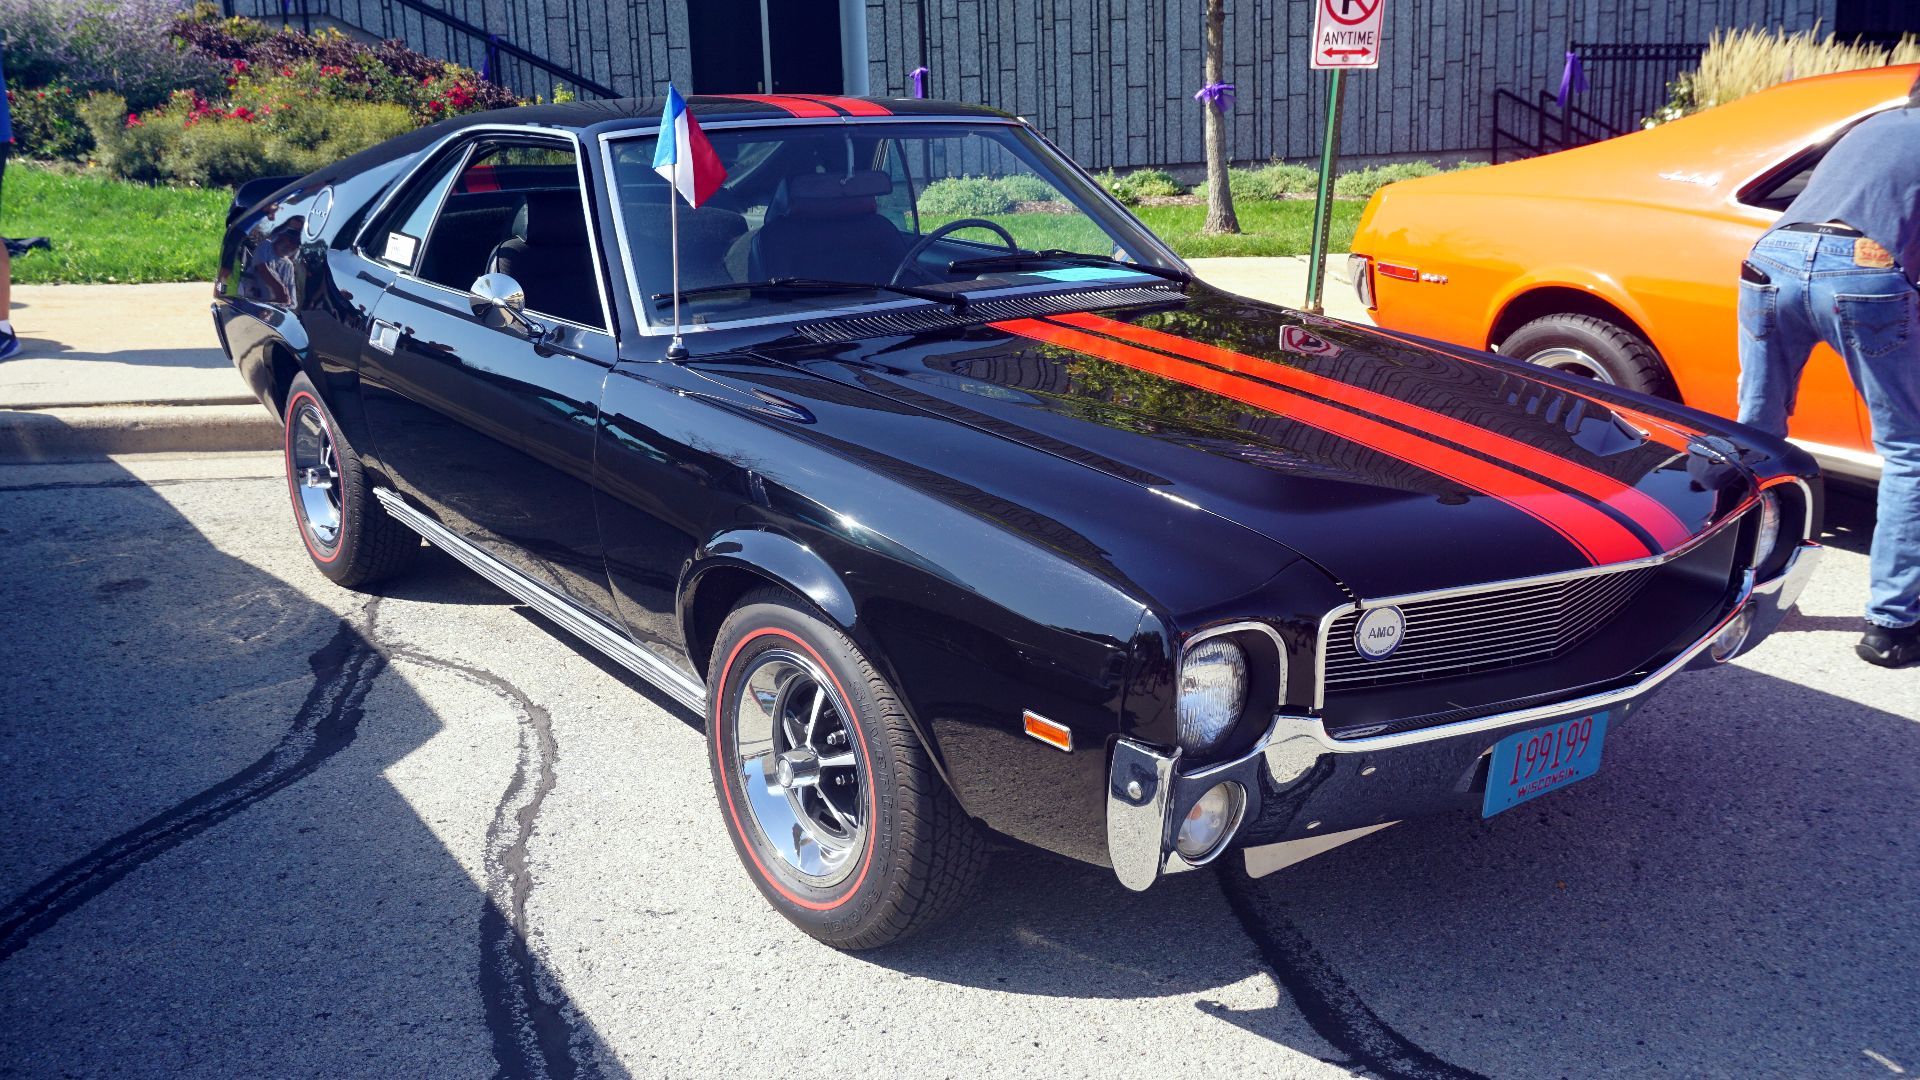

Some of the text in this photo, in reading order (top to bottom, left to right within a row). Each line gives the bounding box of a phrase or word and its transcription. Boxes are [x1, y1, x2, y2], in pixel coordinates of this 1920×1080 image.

[1323, 31, 1374, 45] ANYTIME
[1368, 625, 1395, 639] AMO
[1509, 716, 1593, 786] 199199
[1518, 766, 1574, 798] WISCONSIN
